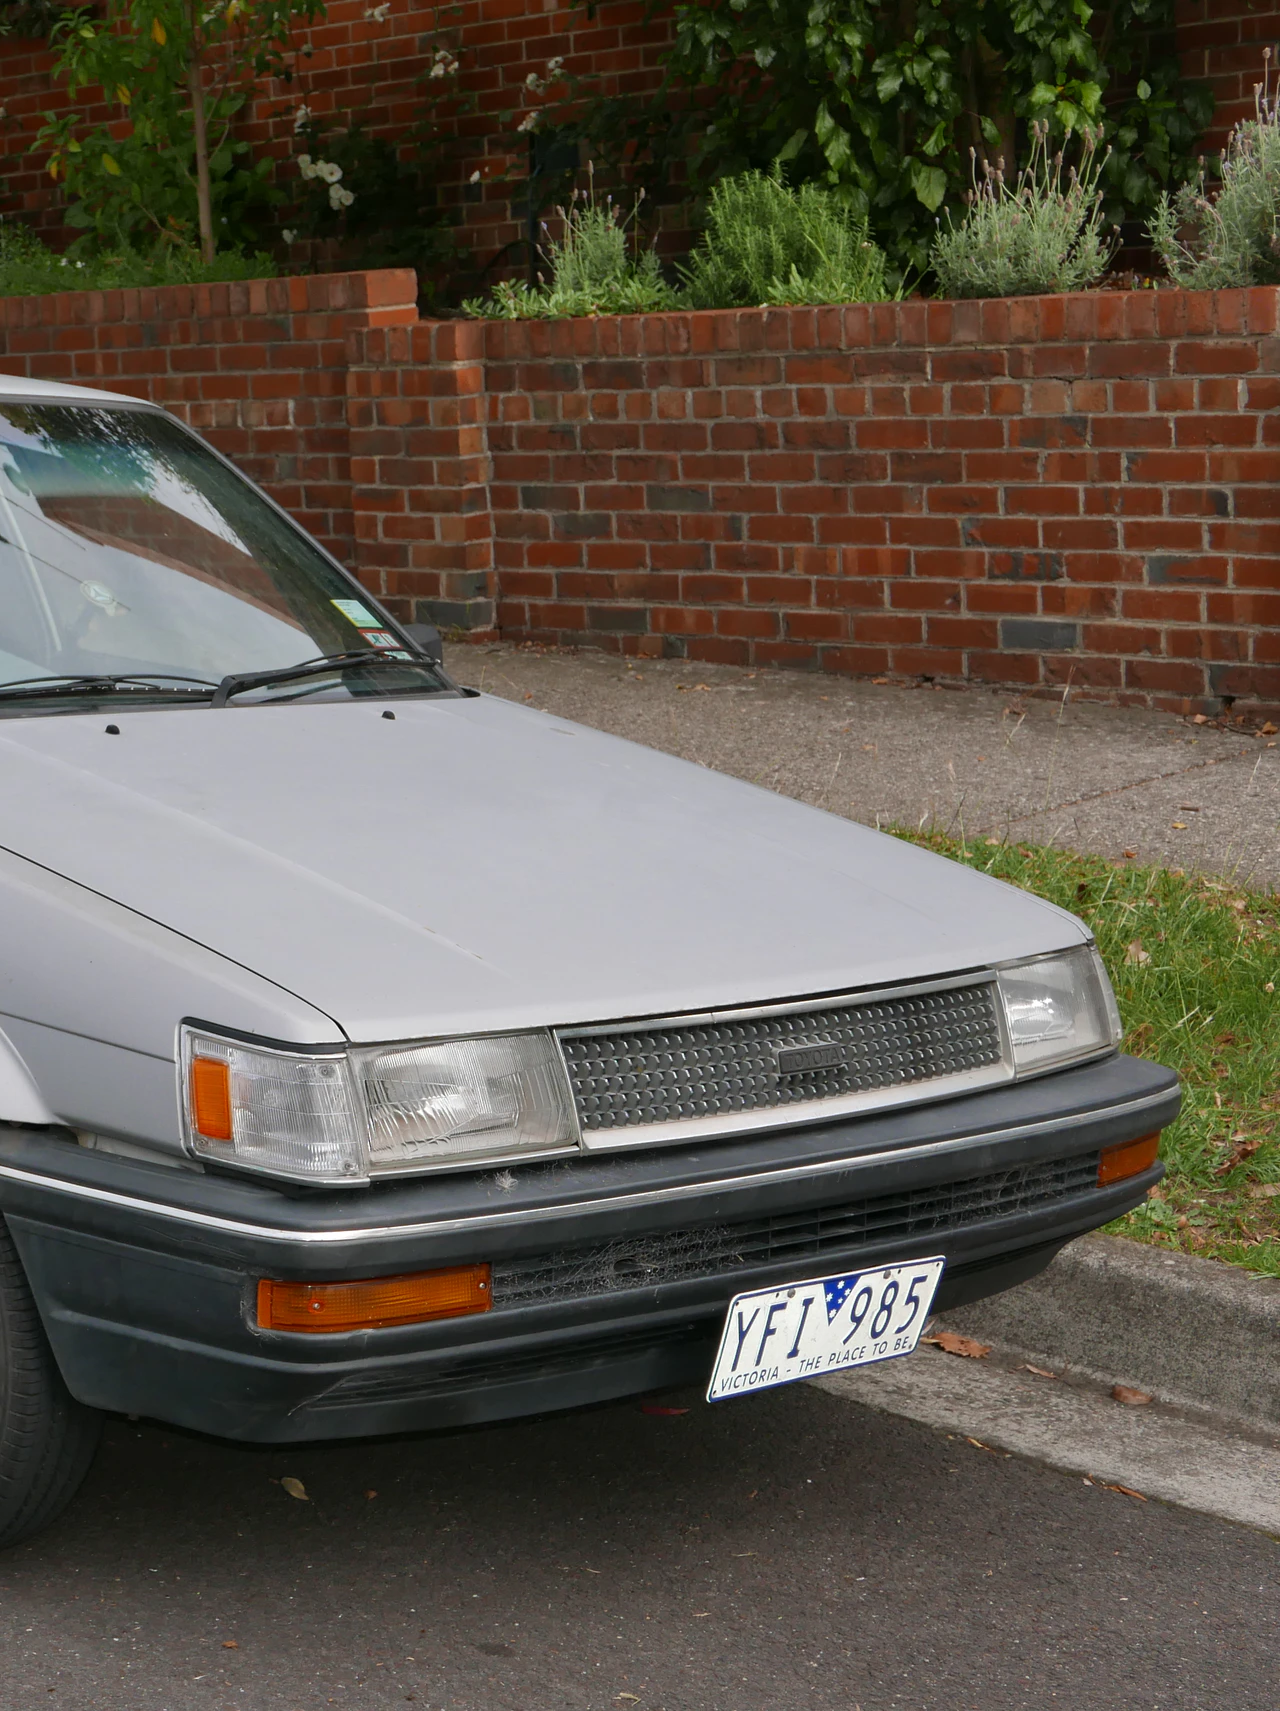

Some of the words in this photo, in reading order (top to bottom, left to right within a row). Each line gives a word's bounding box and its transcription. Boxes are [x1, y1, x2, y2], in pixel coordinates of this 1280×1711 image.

[784, 1047, 840, 1069] TOYOTA
[731, 1296, 816, 1373] YFI
[842, 1274, 929, 1346] 985
[721, 1365, 779, 1392] VICTORIA
[799, 1355, 823, 1373] THE
[828, 1345, 867, 1366] PLACE
[872, 1340, 889, 1355] TO
[893, 1335, 910, 1351] BE
